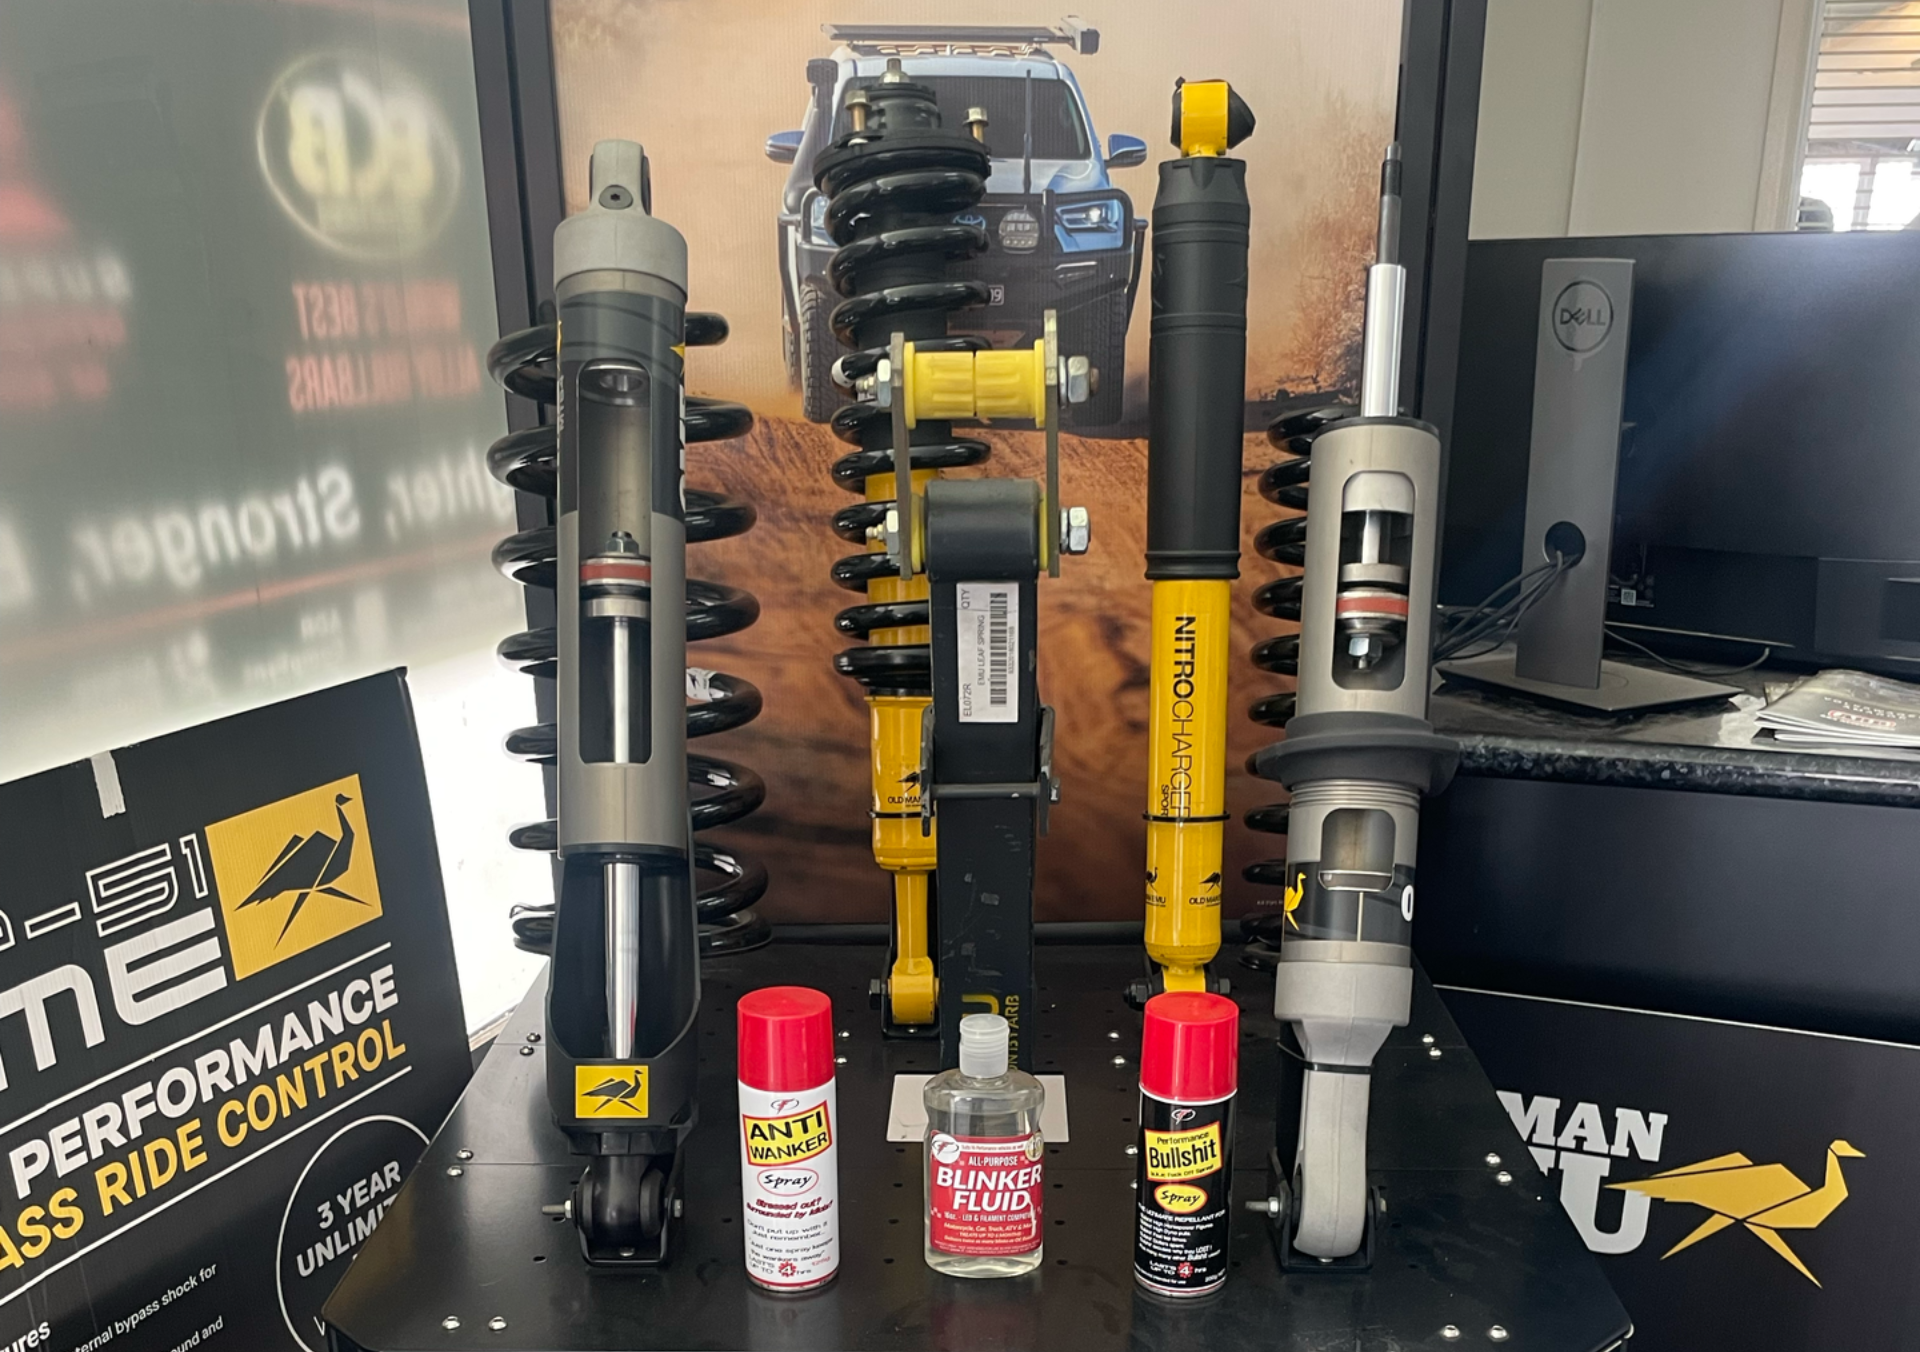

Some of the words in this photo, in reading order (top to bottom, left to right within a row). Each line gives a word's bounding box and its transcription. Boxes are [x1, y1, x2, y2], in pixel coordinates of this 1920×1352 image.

[1560, 308, 1606, 326] DELL
[961, 588, 971, 609] QTY
[977, 614, 985, 645] SPRING
[977, 646, 985, 667] LEAF
[977, 668, 985, 686] EMU
[963, 683, 973, 717] EL072R
[888, 796, 903, 804] OLD
[1189, 897, 1205, 905] OLD
[1004, 994, 1019, 1029] ARB
[9, 964, 399, 1200] PERFORMANCE
[94, 1118, 208, 1217] RIDE
[217, 1019, 407, 1148] CONTROL
[750, 1110, 823, 1141] ANTI
[1496, 1089, 1668, 1162] MAN
[750, 1131, 828, 1160] WANKER
[1156, 1132, 1209, 1145] Performance
[968, 1155, 1018, 1167] ALL-PURPOSE
[1149, 1139, 1217, 1169] Bullshit
[763, 1174, 812, 1190] Spray
[936, 1163, 1042, 1190] BLINKER
[317, 1201, 334, 1229] 3
[337, 1161, 401, 1216] YEAR
[953, 1190, 1030, 1212] FLUID
[1160, 1189, 1201, 1207] Spray
[780, 1265, 793, 1275] 4
[1180, 1265, 1189, 1275] 4
[115, 1299, 160, 1335] bypass
[162, 1275, 198, 1306] shock
[199, 1263, 218, 1283] for
[201, 1314, 225, 1341] and
